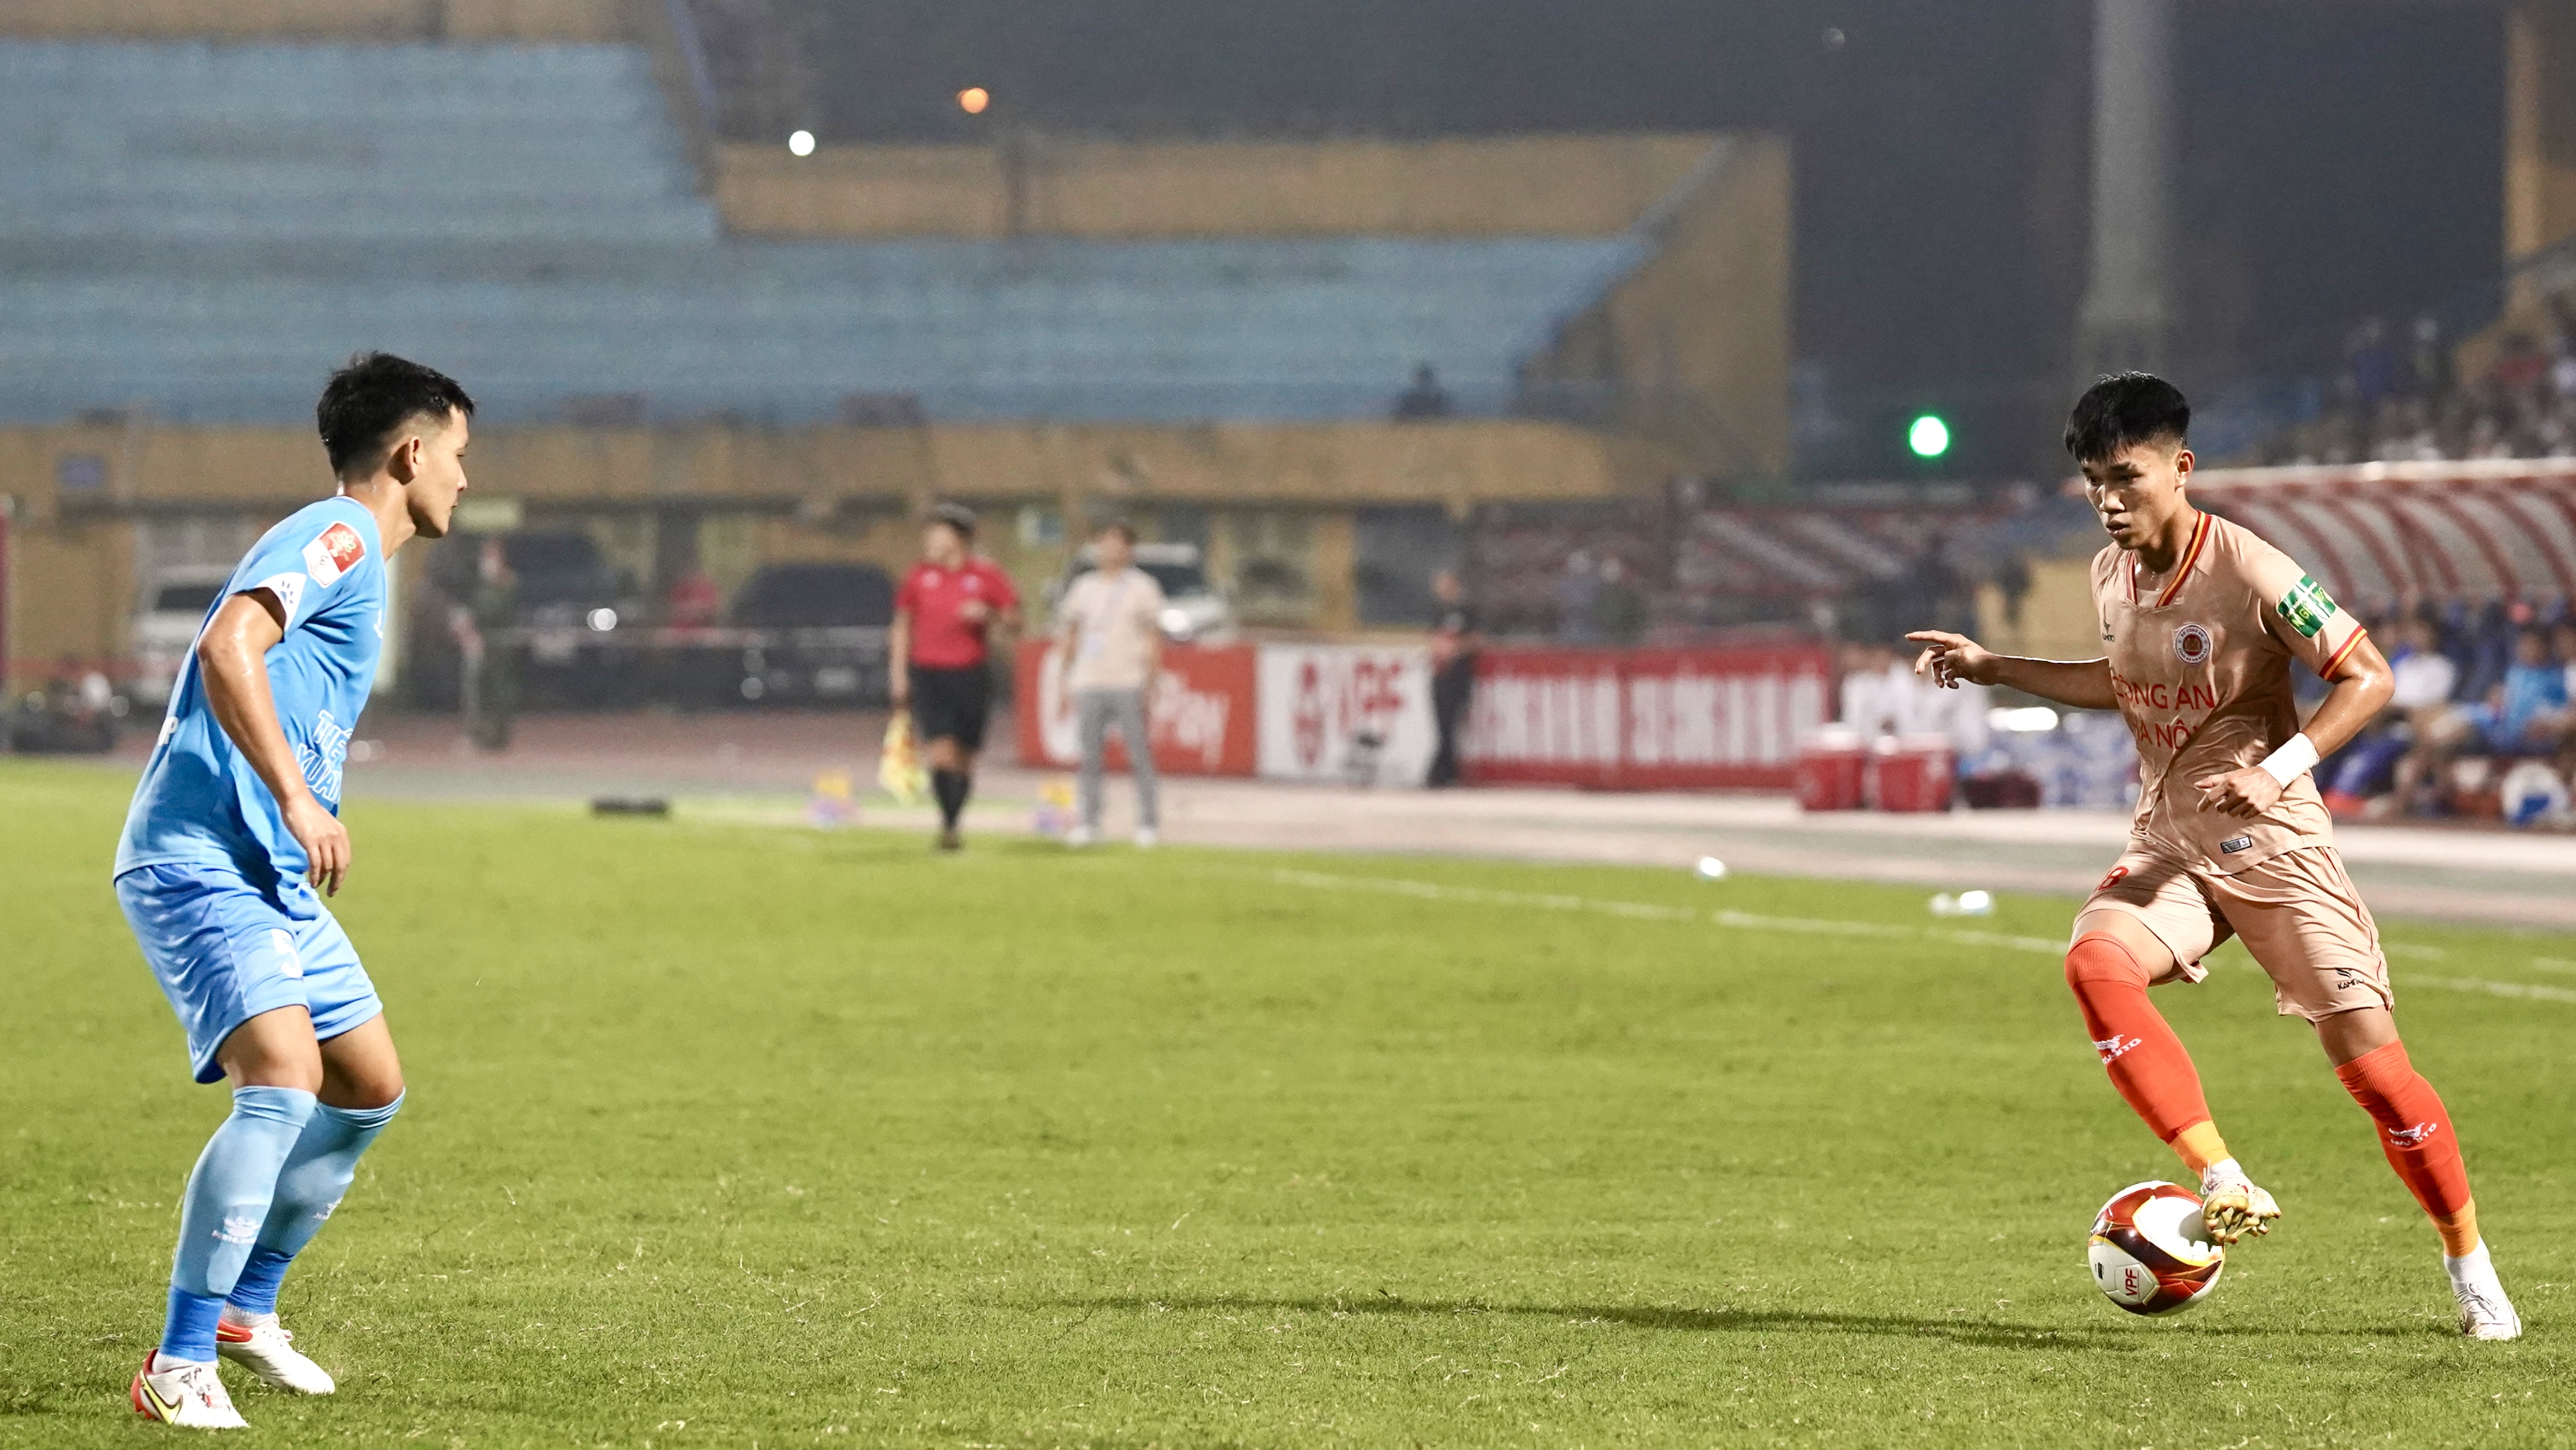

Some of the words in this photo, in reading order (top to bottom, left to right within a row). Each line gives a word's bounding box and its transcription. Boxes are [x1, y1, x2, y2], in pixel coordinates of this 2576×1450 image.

[2175, 684, 2215, 710] AN
[2098, 867, 2129, 891] 8
[271, 928, 303, 978] 5
[2125, 1268, 2138, 1296] VPF
